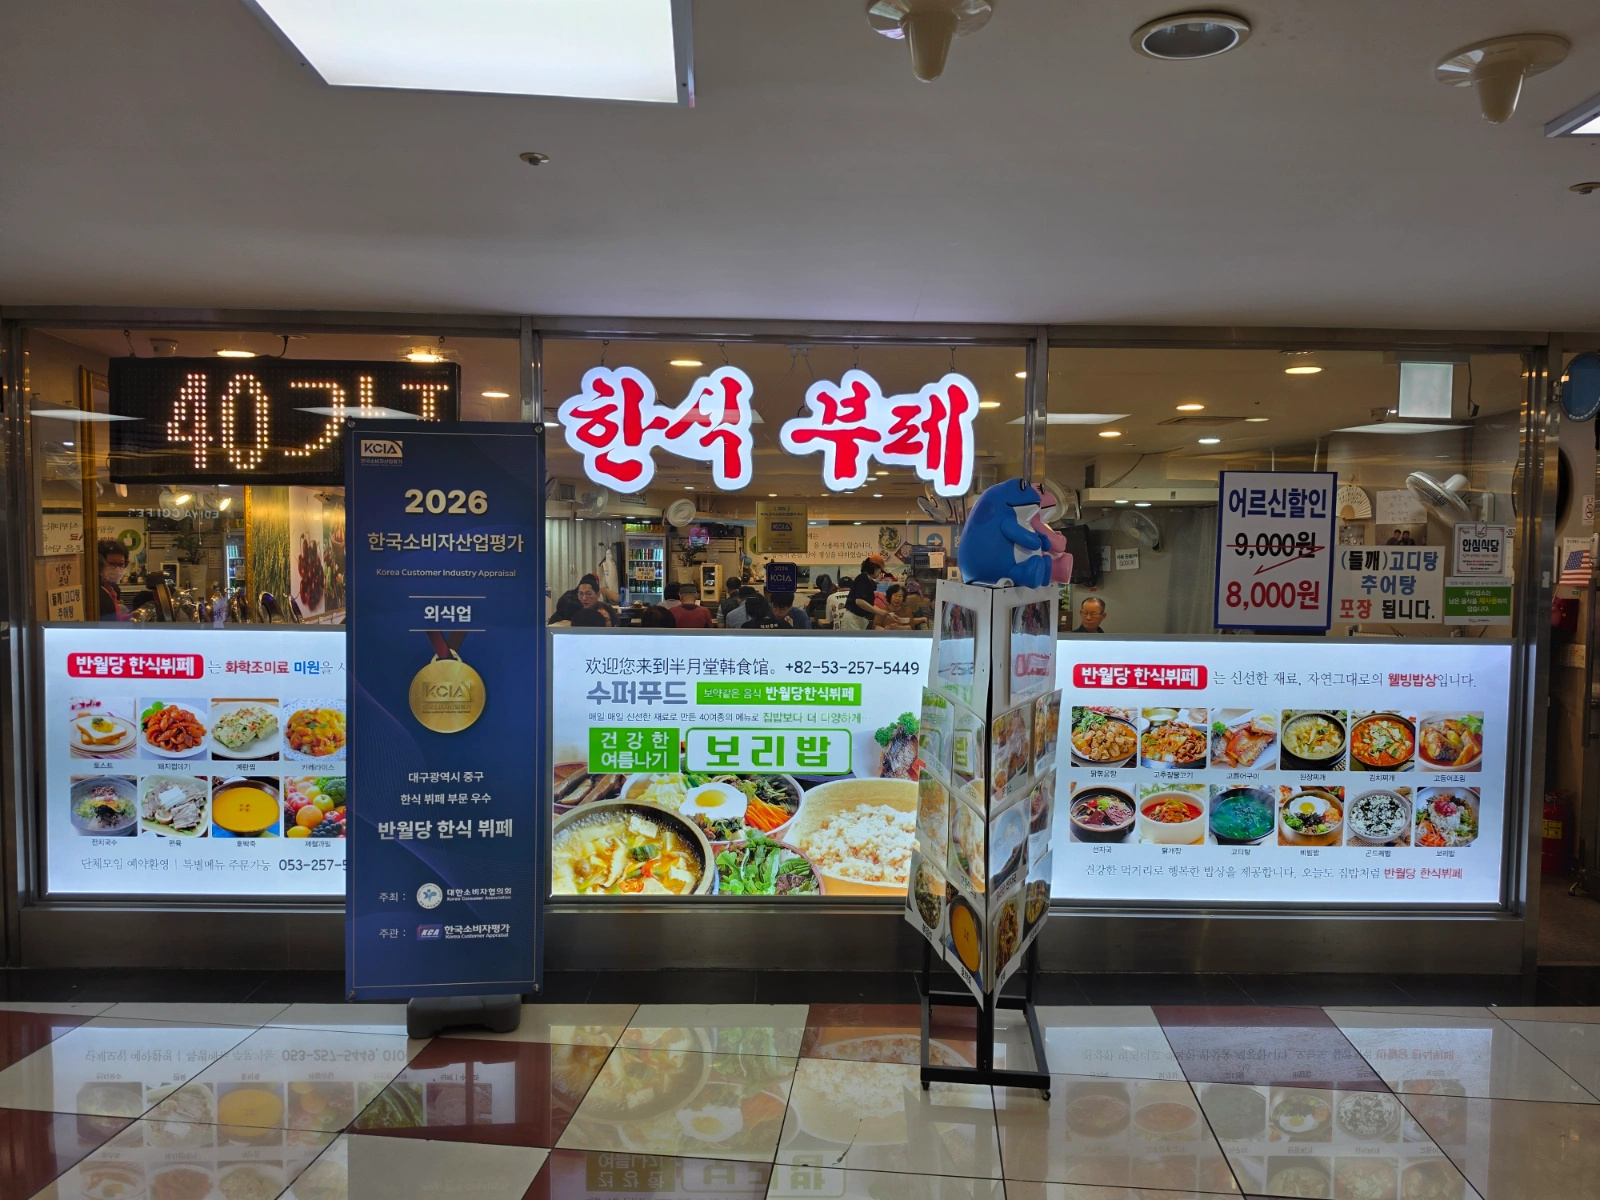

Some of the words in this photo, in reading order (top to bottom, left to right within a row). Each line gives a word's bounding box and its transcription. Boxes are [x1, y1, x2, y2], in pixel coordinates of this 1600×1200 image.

[570, 376, 742, 482] 한식
[364, 443, 398, 454] KCIA
[404, 489, 488, 514] 2026
[1228, 487, 1327, 520] 어르신할인
[368, 532, 524, 552] 한국소비자산업평가
[1234, 531, 1316, 559] 9,000원
[1462, 539, 1500, 552] 안심식당
[1341, 551, 1439, 572] (들깨)고디탕
[443, 569, 476, 578] Industry
[478, 569, 516, 577] Appraisal
[770, 574, 792, 582] KCIA
[1361, 575, 1416, 596] 추어탕
[1226, 581, 1320, 611] 8,000원
[424, 606, 472, 622] 외식업
[1340, 599, 1372, 619] 포장
[1382, 599, 1435, 619] 됩니다.
[76, 656, 125, 675] 반월당
[129, 657, 194, 677] 한식뷔페
[225, 660, 290, 674] 화학조미료
[585, 657, 775, 676] 欢迎您来到半月堂韩食馆。
[785, 661, 920, 675] +82-53-257-5449
[1081, 667, 1130, 685] 반월당
[1134, 667, 1198, 687] 한식뷔페
[1230, 671, 1268, 685] 신선한
[1307, 672, 1383, 686] 자연그대로의
[425, 685, 466, 698] KCIA
[586, 681, 688, 705] 수퍼푸드
[703, 688, 740, 699] 보약같은
[743, 689, 762, 699] 음식
[766, 686, 854, 702] 반월당한식뷔페
[588, 712, 604, 721] 매일
[607, 712, 623, 721] 매일
[626, 712, 650, 721] 신선한
[654, 712, 678, 721] 재료로
[680, 713, 696, 721] 만든
[699, 713, 733, 721] 40여종의
[735, 713, 759, 722] 메뉴로
[763, 712, 803, 723] 집밥보다
[807, 713, 817, 723] 더
[601, 751, 668, 769] 여름나기
[706, 736, 831, 767] 보리밥
[408, 772, 460, 783] 대구광역시
[463, 772, 484, 782] 중구
[1369, 774, 1396, 782] 김치찌개
[400, 794, 421, 805] 한식
[424, 794, 445, 804] 뷔페
[447, 793, 468, 804] 부문
[471, 793, 491, 804] 우수
[378, 820, 432, 840] 반월당
[437, 819, 472, 839] 한식
[478, 818, 513, 838] 뷔페
[81, 858, 123, 869] 단체모임
[126, 858, 170, 870] 예약환영
[182, 859, 225, 870] 특별메뉴
[228, 859, 271, 871] 주문가능
[1085, 864, 1117, 876] 건강한
[1121, 864, 1164, 876] 먹거리로
[1168, 865, 1200, 877] 행복한
[1204, 866, 1236, 878] 밥상을
[1301, 867, 1334, 879] 오늘도
[1338, 867, 1380, 879] 집밥처럼
[1384, 867, 1416, 879] 반월당
[1420, 867, 1463, 880] 한식뷔페
[379, 892, 398, 902] 주최
[446, 888, 512, 897] 대한소비자협의회
[379, 929, 398, 938] 주관
[444, 924, 510, 934] 한국소비자평가
